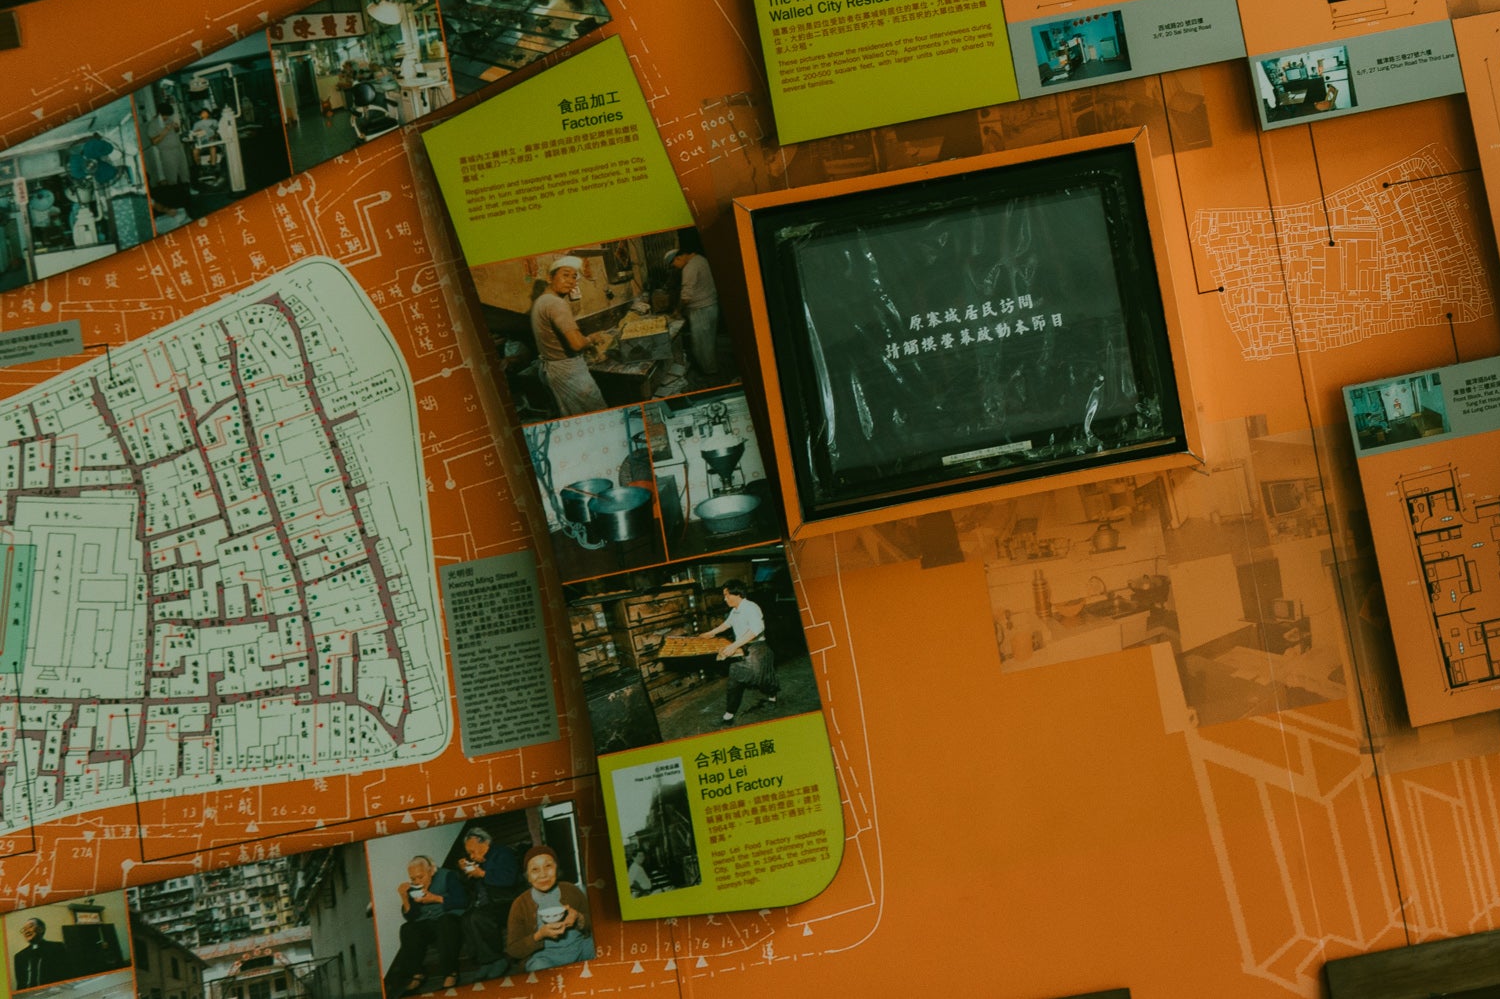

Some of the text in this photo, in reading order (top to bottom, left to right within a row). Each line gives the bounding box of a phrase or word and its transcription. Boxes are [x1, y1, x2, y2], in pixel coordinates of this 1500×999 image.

[768, 3, 813, 22] Walled
[817, 0, 842, 13] City
[557, 90, 620, 114] 食品加工
[561, 111, 623, 130] Factories
[680, 145, 706, 162] Out
[448, 570, 518, 590] Kwong Ming Street
[694, 738, 776, 769] 合利食品廠
[698, 764, 747, 785] Hap Lei
[700, 775, 783, 800] Food Factory
